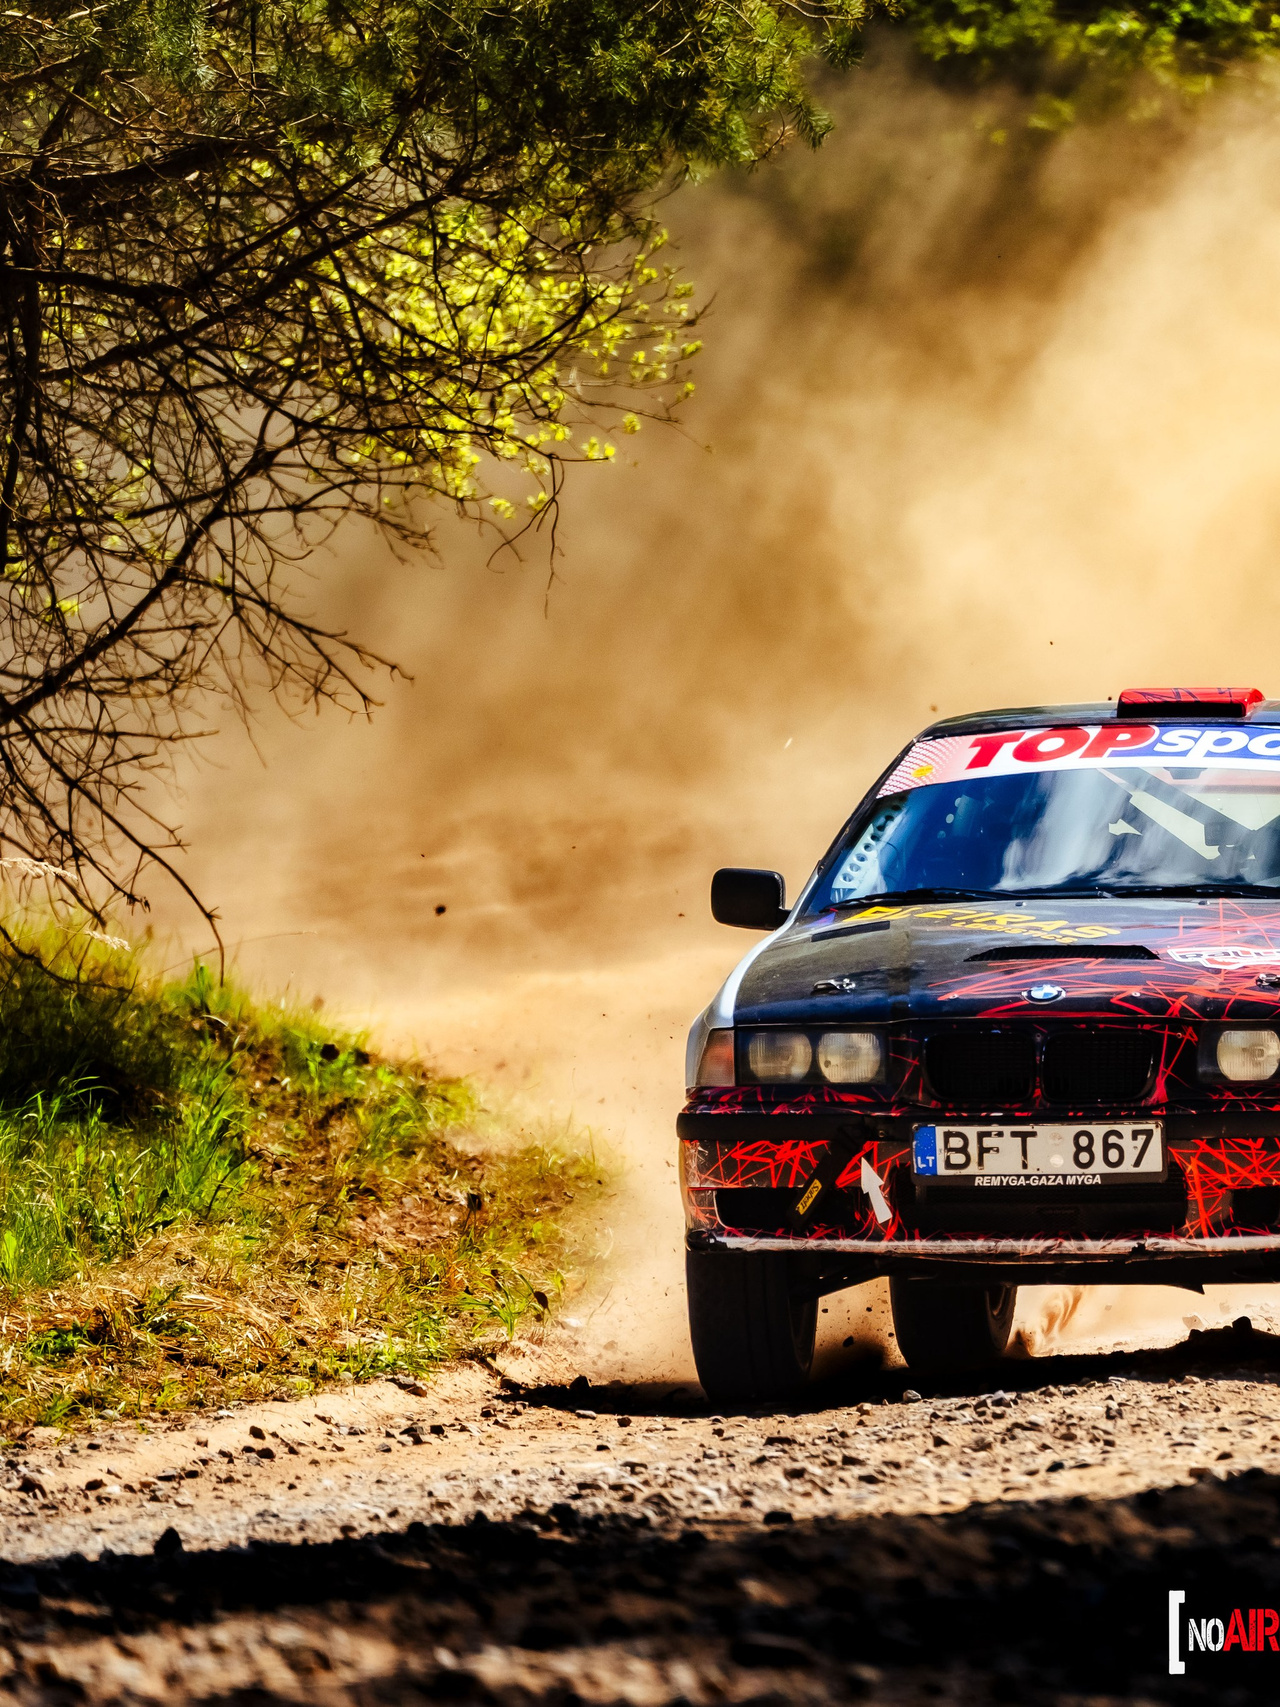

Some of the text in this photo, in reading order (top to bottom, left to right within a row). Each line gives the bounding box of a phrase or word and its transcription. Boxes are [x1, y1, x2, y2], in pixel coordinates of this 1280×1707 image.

[943, 1129, 1155, 1170] BFT 867
[917, 1156, 935, 1168] LT
[974, 1174, 1102, 1187] REMYGA-GAZA MYGA
